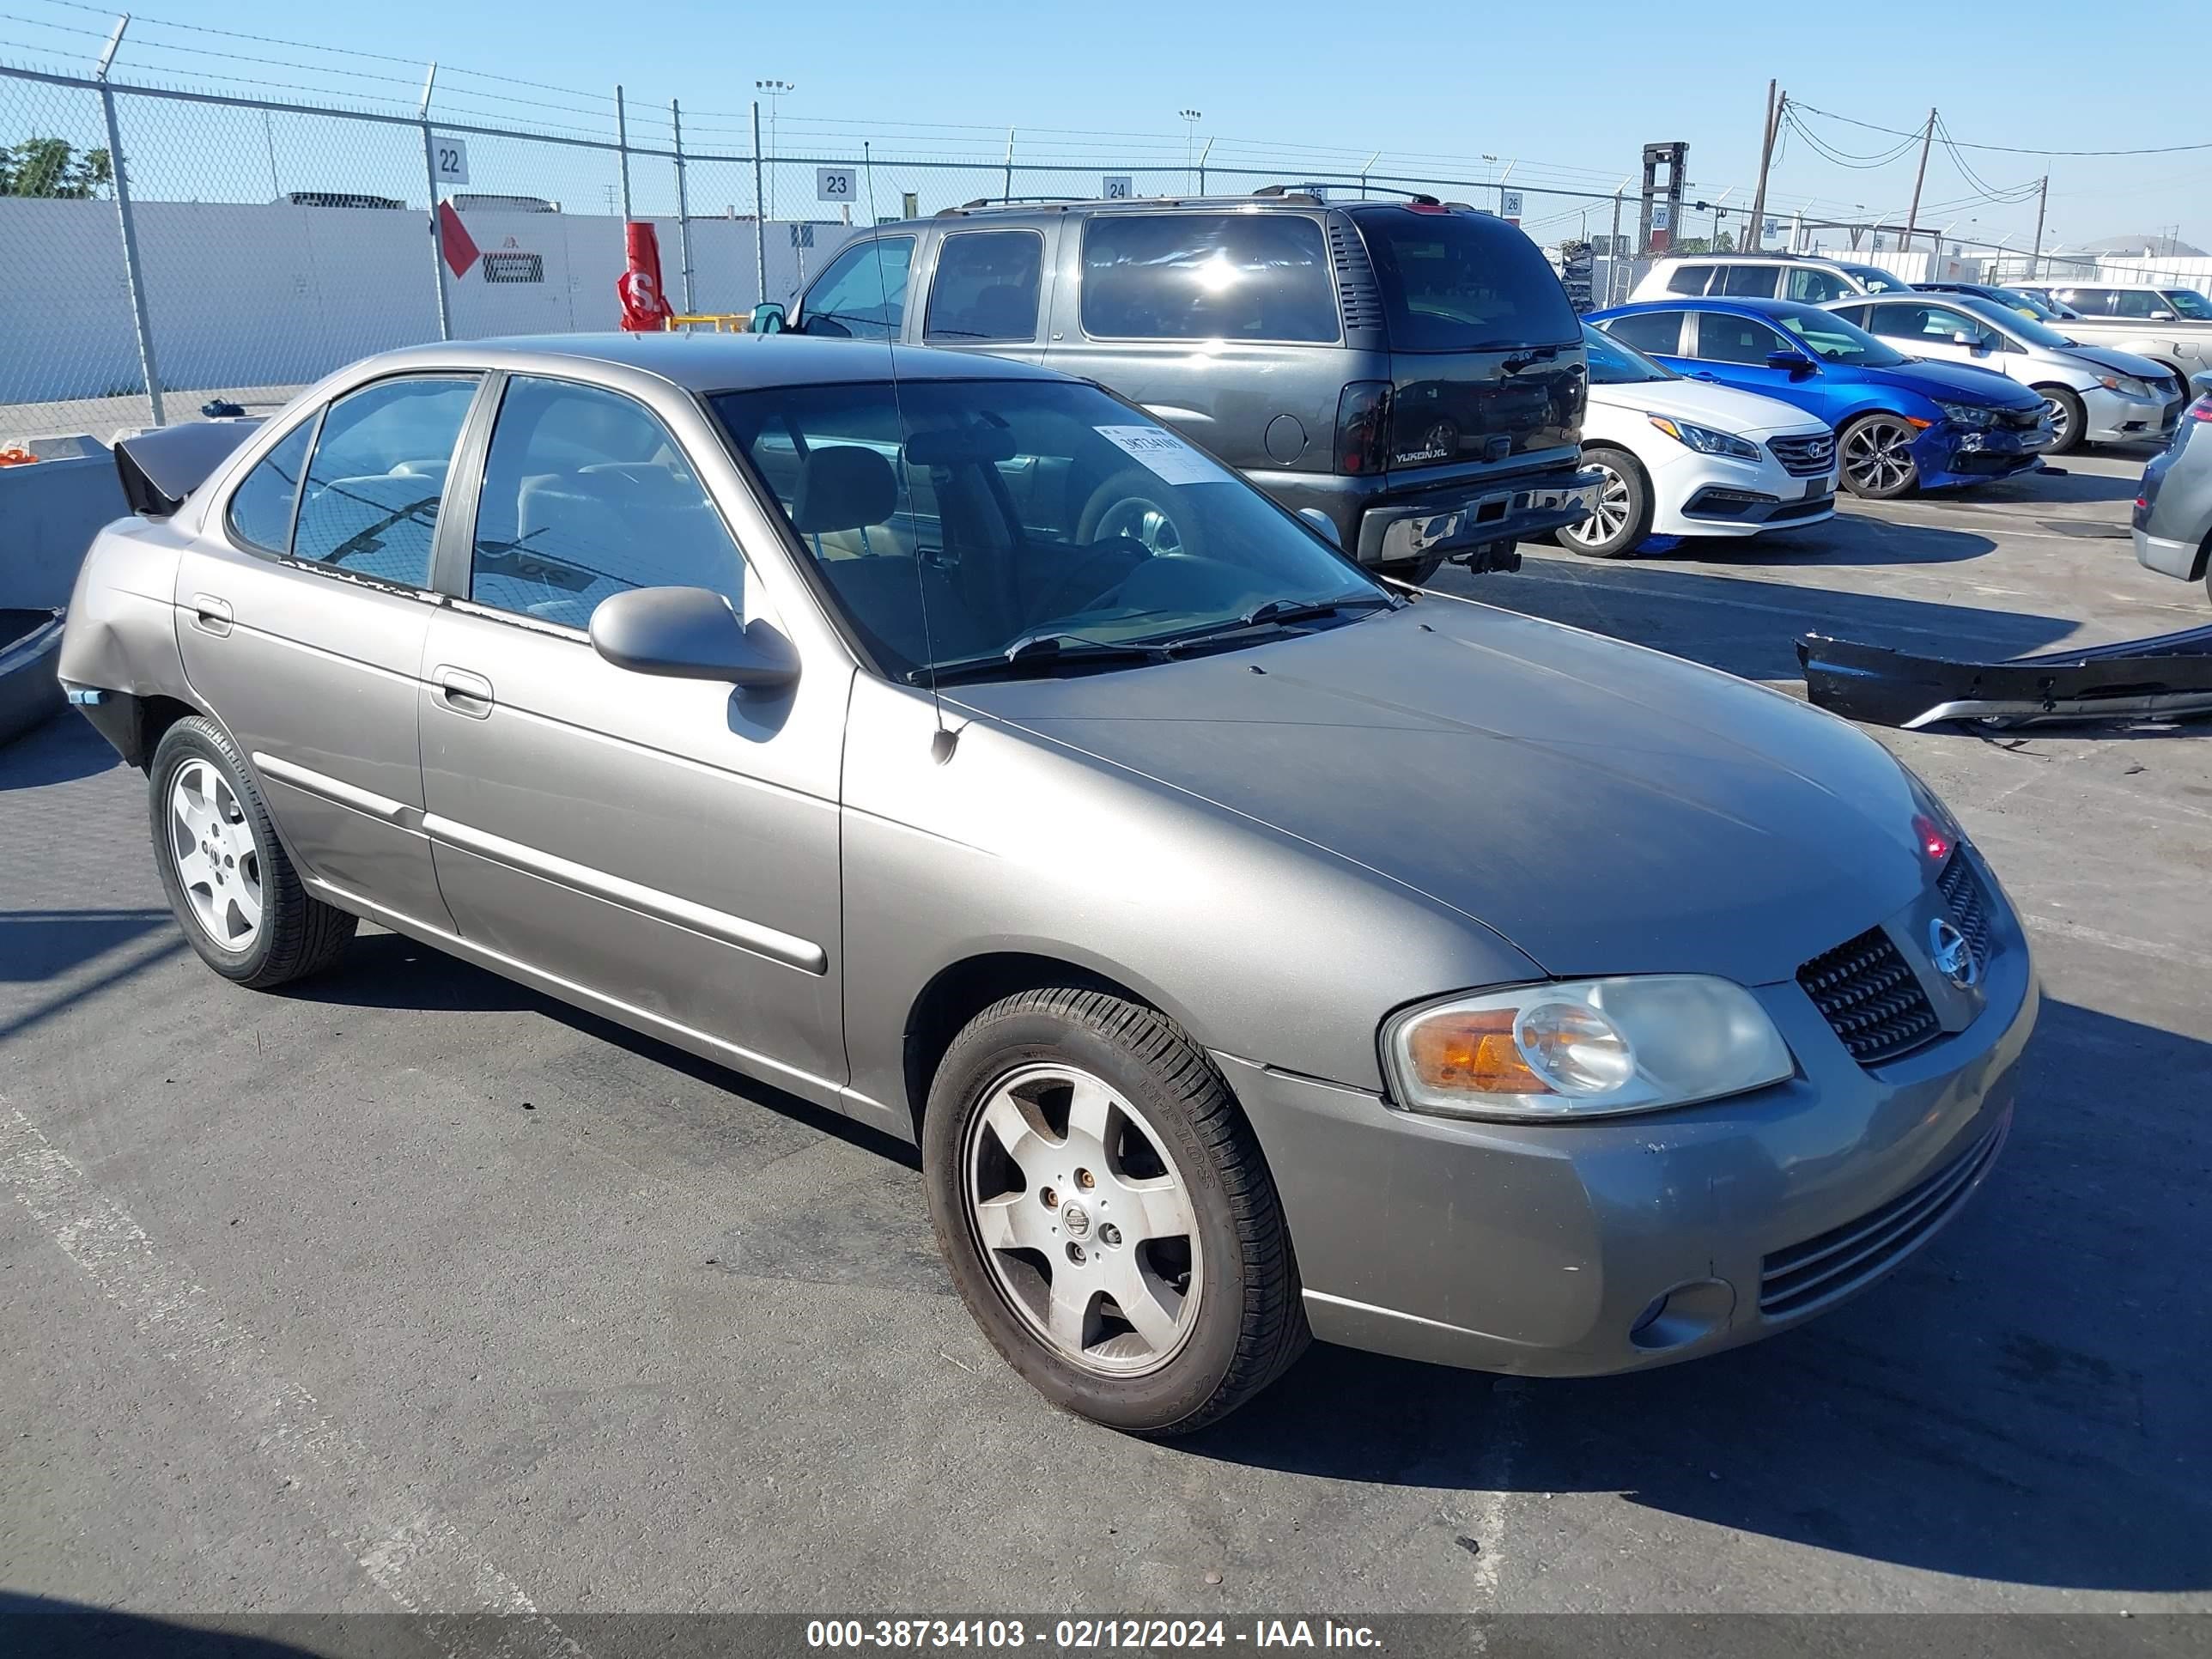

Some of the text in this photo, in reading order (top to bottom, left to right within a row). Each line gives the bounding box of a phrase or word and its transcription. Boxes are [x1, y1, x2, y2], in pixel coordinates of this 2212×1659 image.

[440, 148, 460, 173] 22
[826, 176, 847, 194] 23
[1110, 183, 1125, 199] 24
[1508, 198, 1518, 210] 26
[1656, 212, 1666, 224] 27
[1766, 223, 1775, 234] 28
[1395, 448, 1448, 464] YUKON XL
